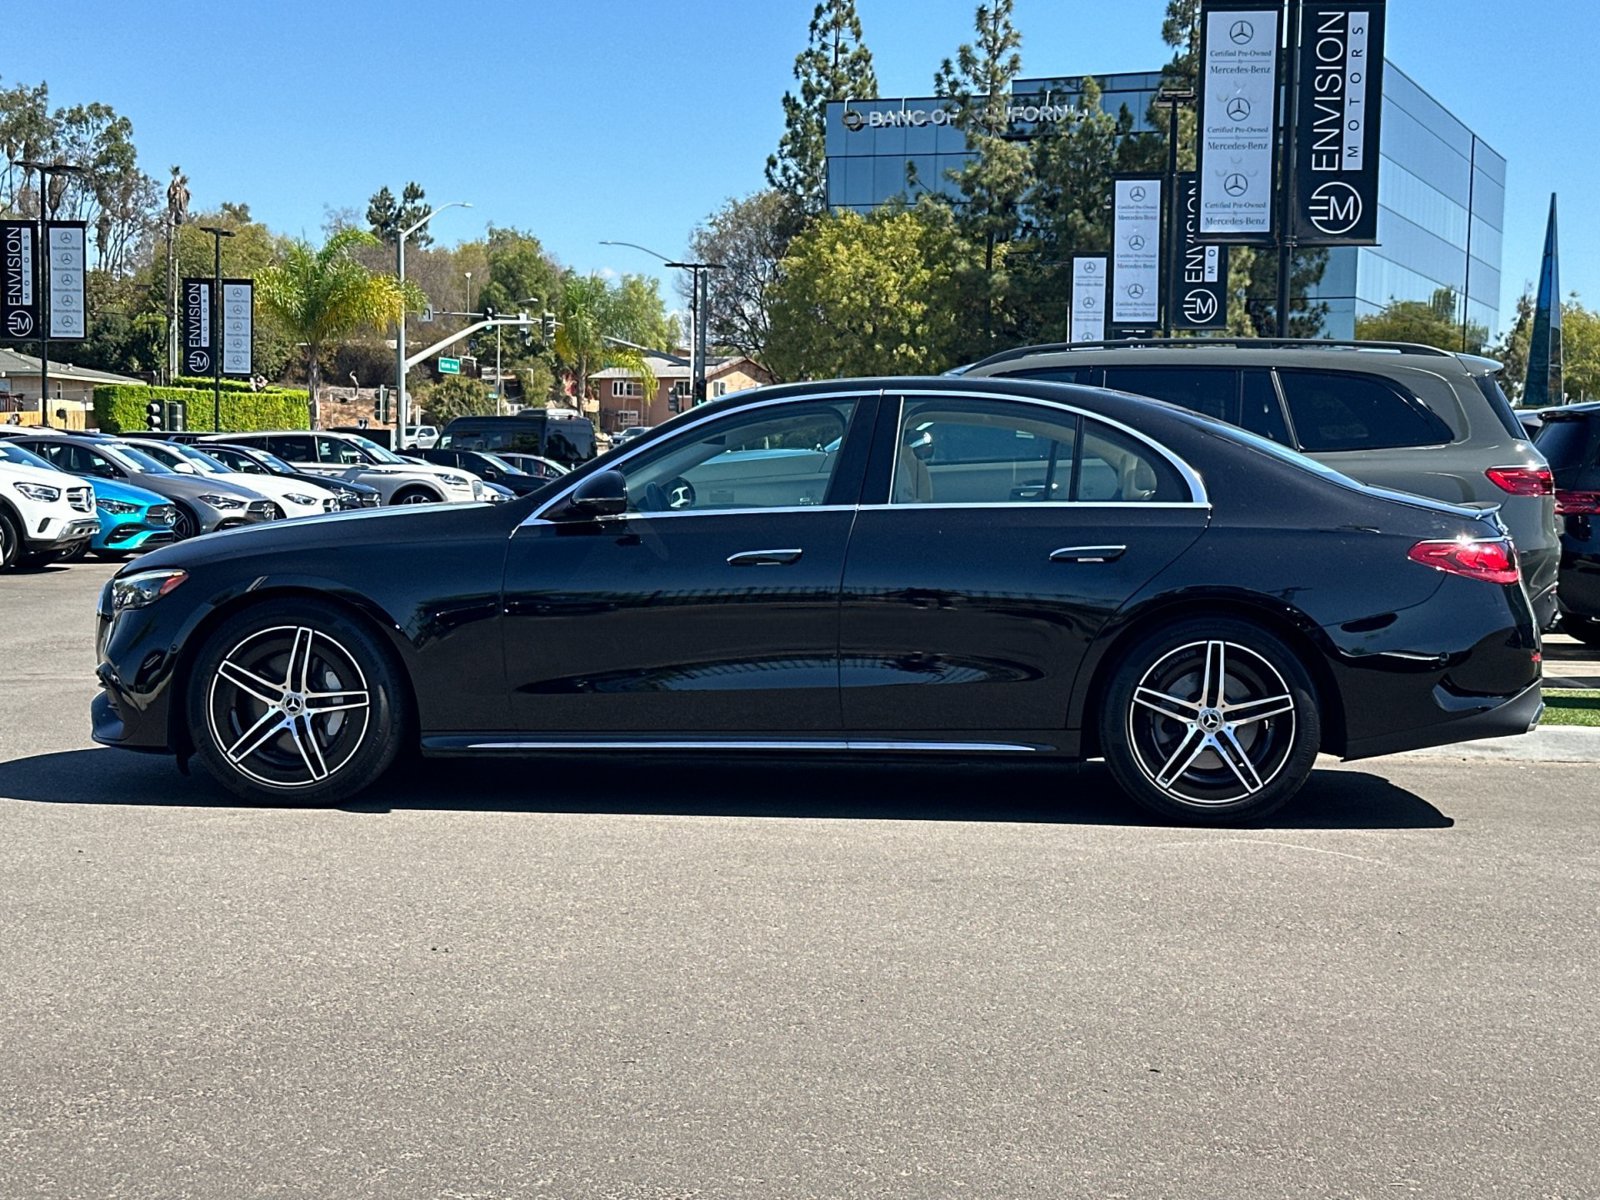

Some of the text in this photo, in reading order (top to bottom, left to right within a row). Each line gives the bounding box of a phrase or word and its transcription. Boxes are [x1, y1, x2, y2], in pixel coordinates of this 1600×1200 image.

[1210, 65, 1271, 75] Mercedes-Benz
[1311, 11, 1345, 171] ENVISION
[1347, 26, 1364, 158] MOTORS
[869, 110, 926, 127] BANC
[1207, 141, 1268, 151] Mercedes-Benz
[1205, 216, 1266, 226] Mercedes-Benz
[6, 227, 22, 306] ENVISION
[188, 283, 201, 348] ENVISION
